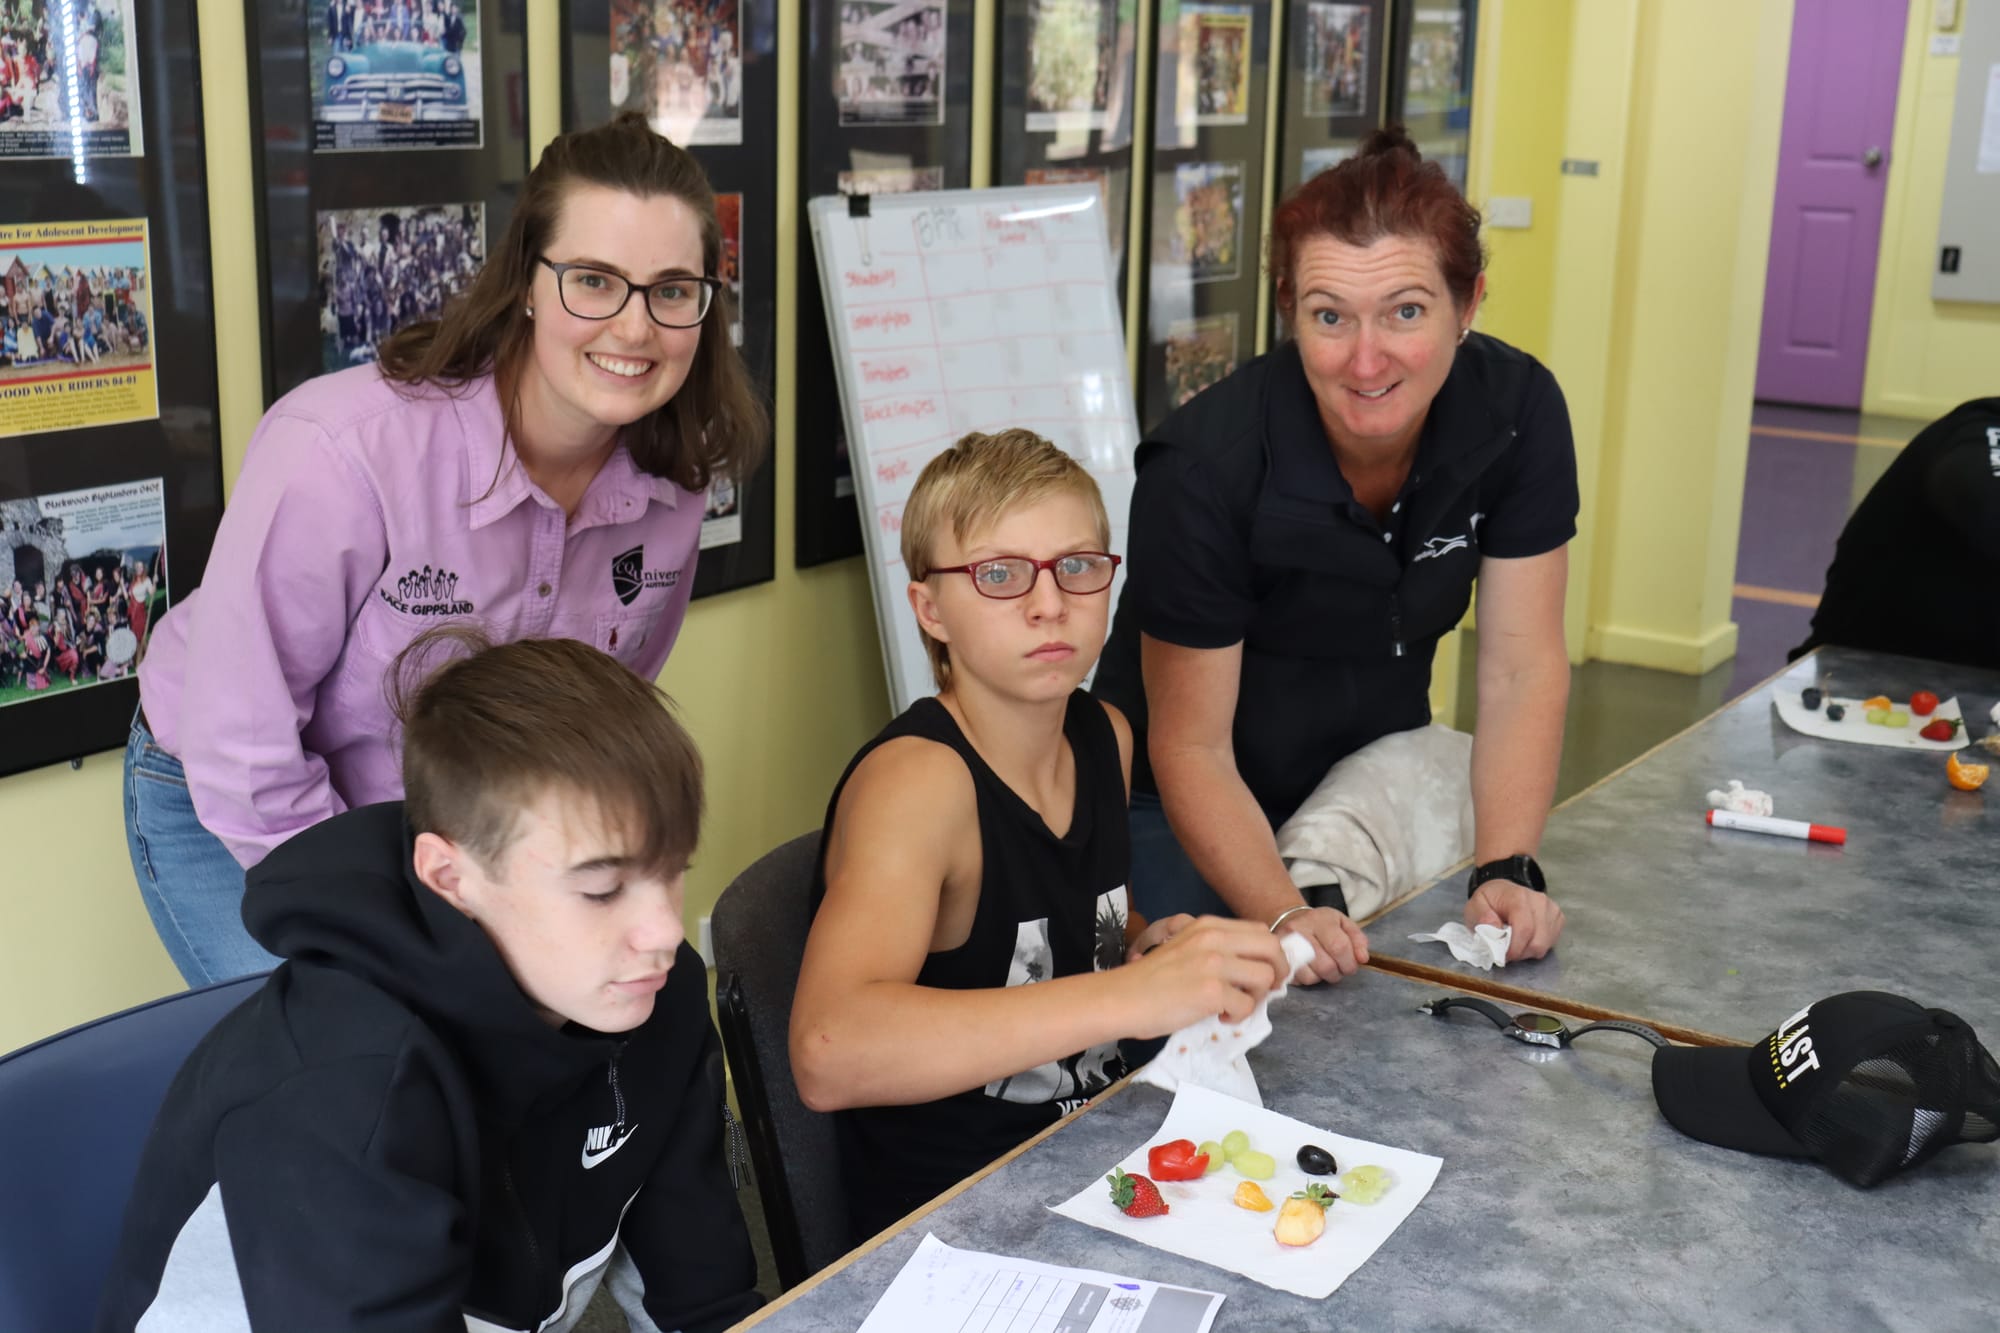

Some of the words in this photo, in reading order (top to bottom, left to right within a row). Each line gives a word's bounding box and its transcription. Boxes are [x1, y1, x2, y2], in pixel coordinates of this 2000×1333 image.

[16, 228, 32, 239] For
[36, 226, 85, 238] Adolescent
[88, 223, 145, 237] Development
[0, 386, 31, 399] OOD
[34, 382, 64, 395] WAVE
[410, 602, 475, 616] GIPPSLAND
